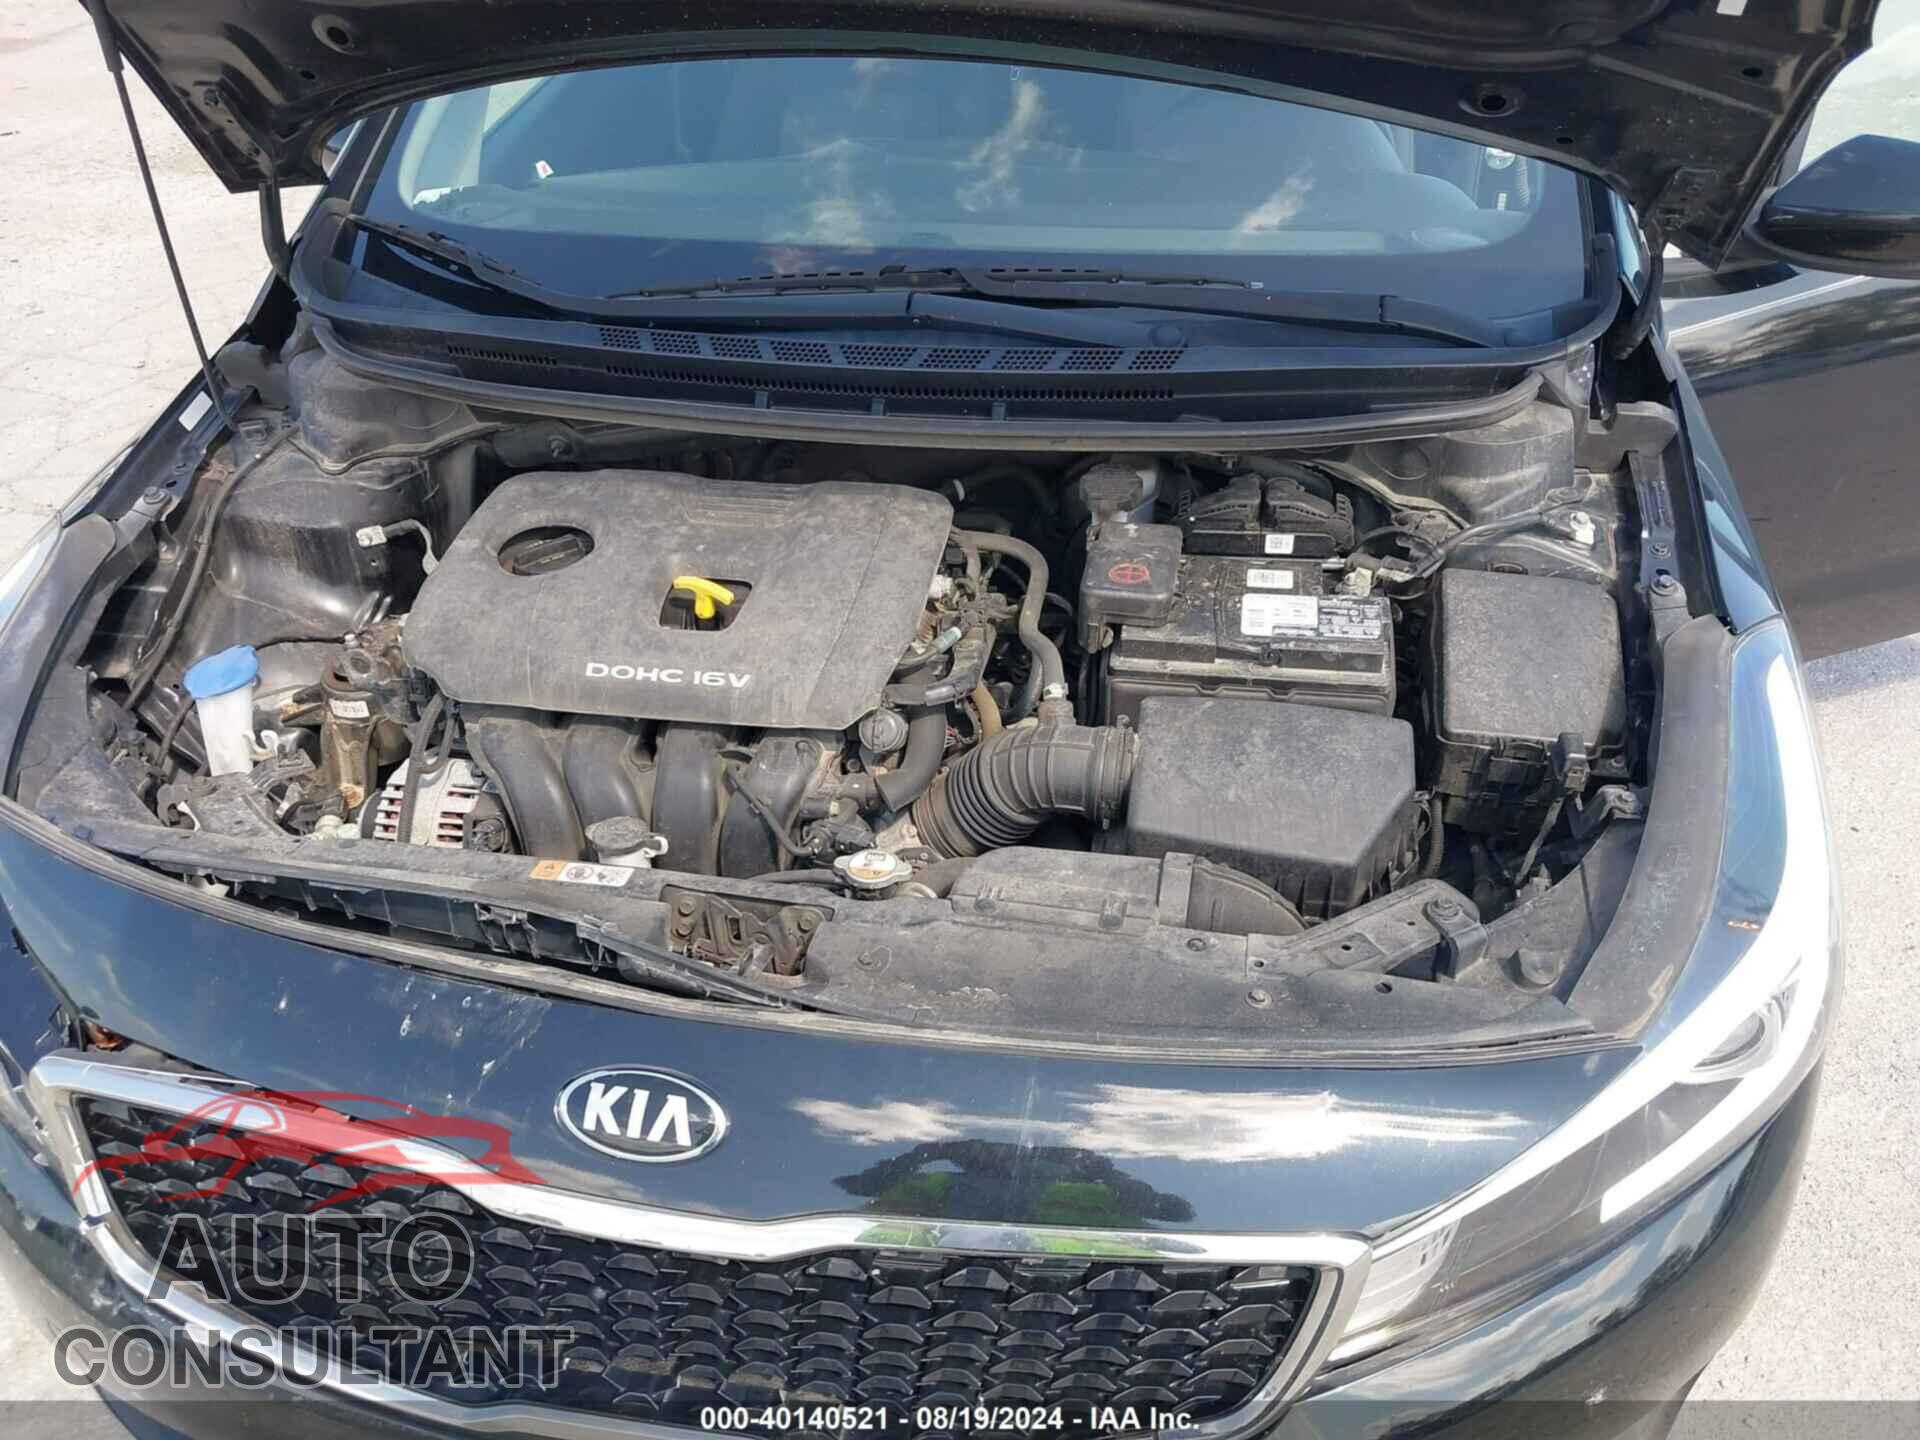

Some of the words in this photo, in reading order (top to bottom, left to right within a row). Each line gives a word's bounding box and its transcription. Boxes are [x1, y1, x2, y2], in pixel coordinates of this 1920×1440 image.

[585, 662, 684, 683] DOHC
[693, 671, 752, 688] 16V
[583, 1081, 692, 1147] KIA
